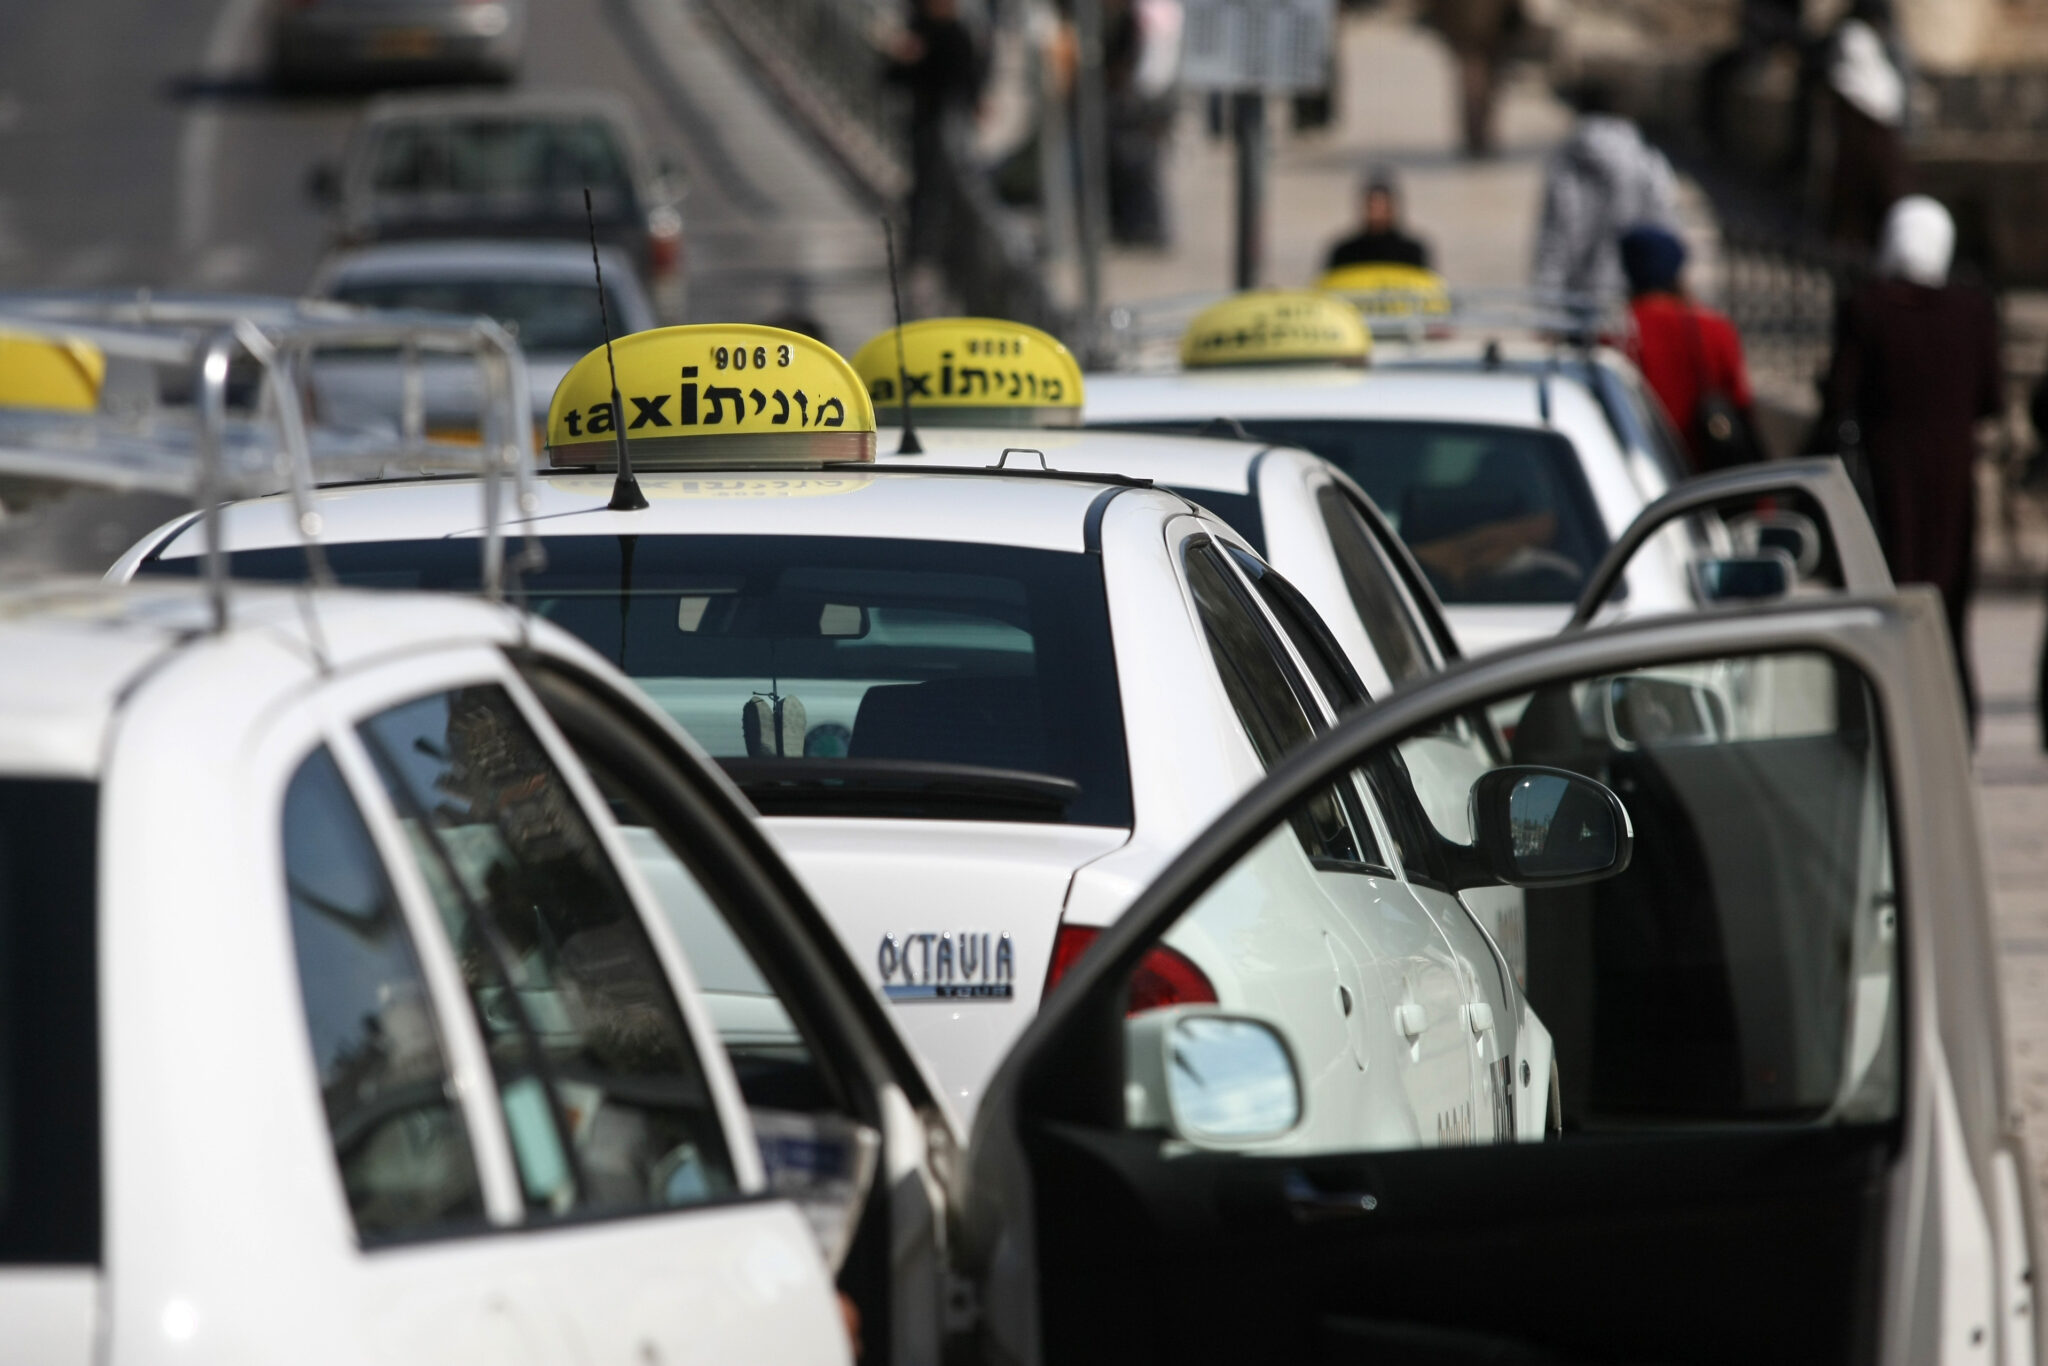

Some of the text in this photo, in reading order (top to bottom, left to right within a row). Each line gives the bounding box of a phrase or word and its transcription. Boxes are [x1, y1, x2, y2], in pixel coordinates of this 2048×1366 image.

[715, 344, 791, 370] 9063
[564, 366, 699, 437] taxi
[703, 384, 845, 428] מונית
[959, 367, 1064, 402] מונית
[878, 932, 1014, 985] OCTAVIA
